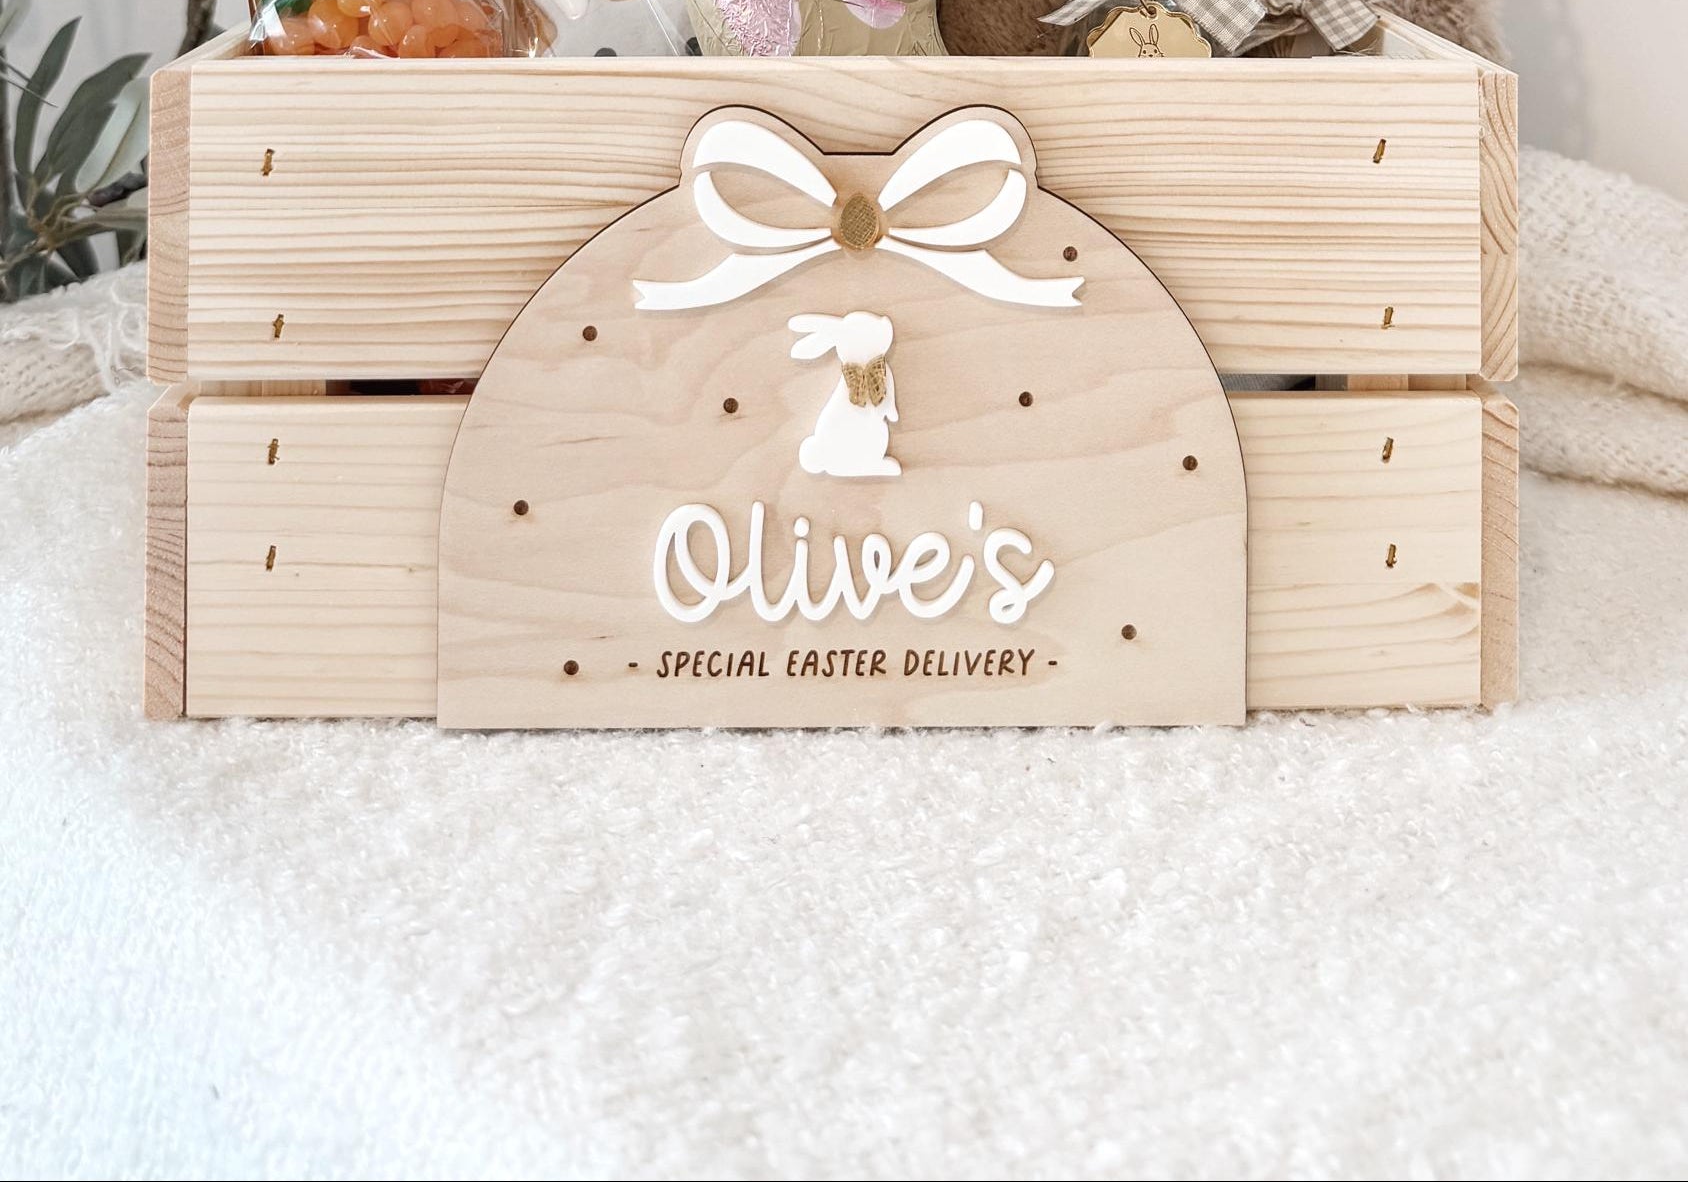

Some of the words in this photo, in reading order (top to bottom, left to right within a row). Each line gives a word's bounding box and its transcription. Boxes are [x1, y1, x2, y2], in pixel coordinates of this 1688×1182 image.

[653, 500, 1056, 624] Olive's
[656, 649, 770, 678] SPECIAL
[786, 649, 888, 677] EASTER
[903, 648, 1036, 676] DELIVERY
